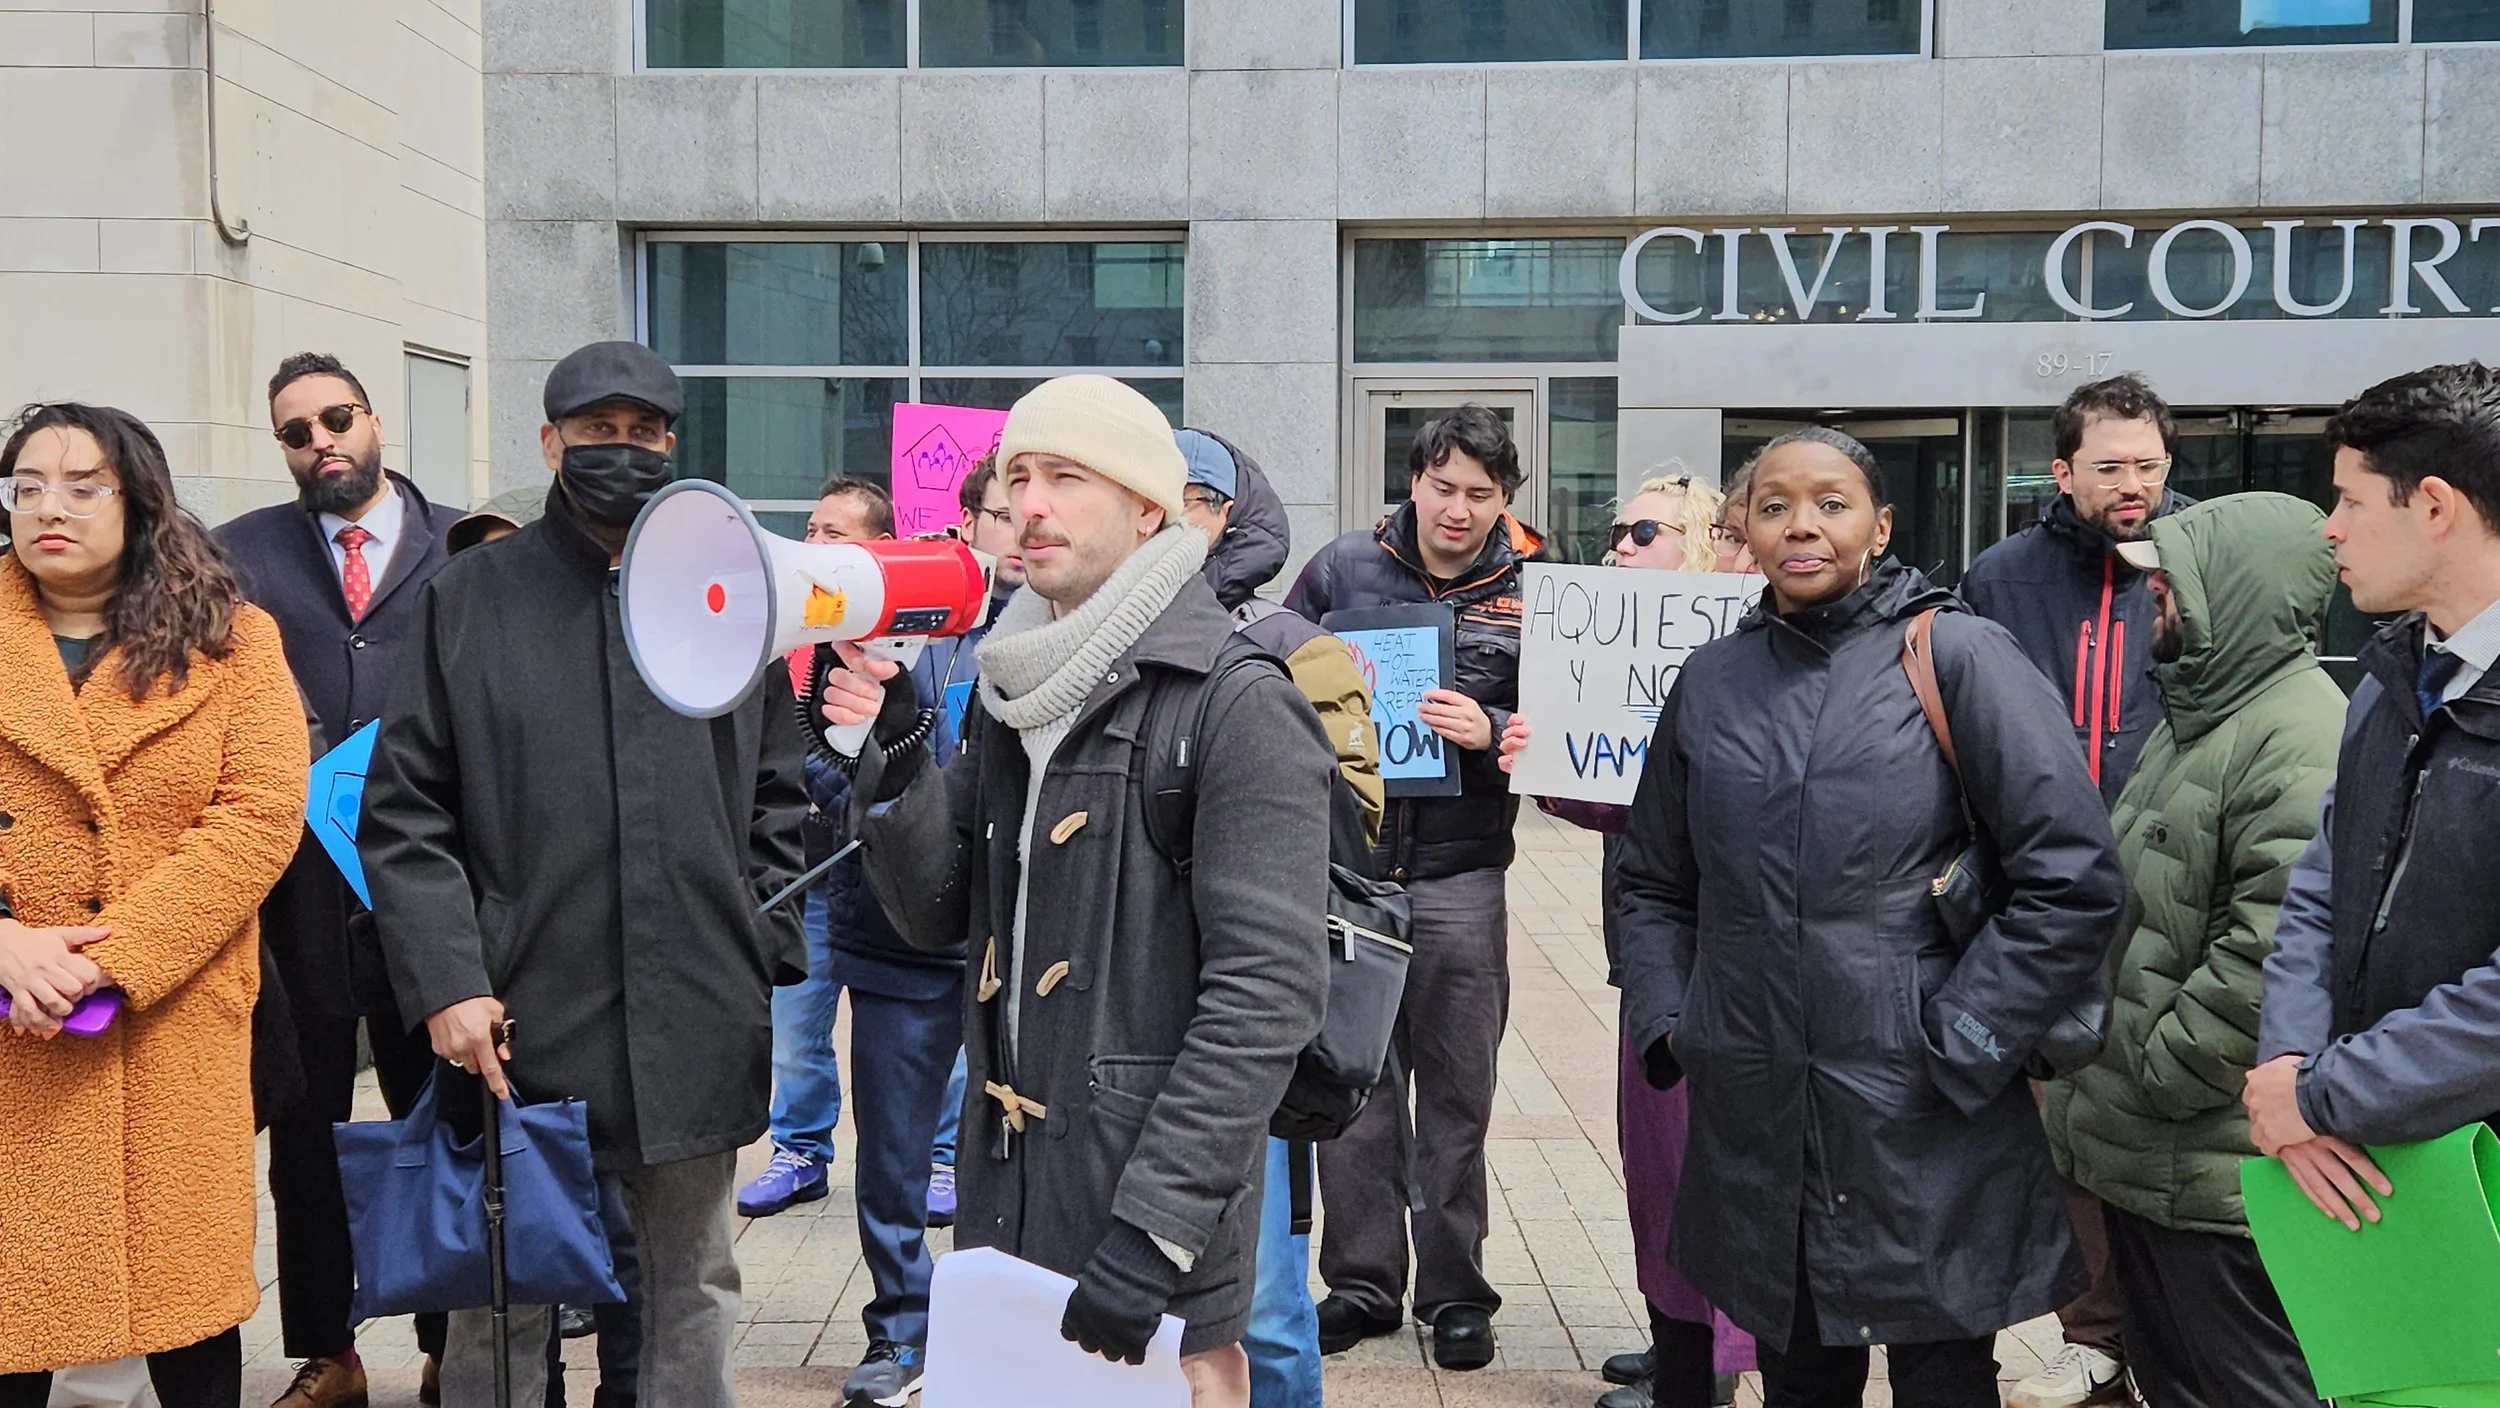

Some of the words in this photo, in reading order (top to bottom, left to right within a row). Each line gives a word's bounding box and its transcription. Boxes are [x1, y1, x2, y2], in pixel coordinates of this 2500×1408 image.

[1619, 225, 1986, 323] CIVIL
[2037, 351, 2113, 378] 89-17
[898, 507, 939, 529] WE
[1529, 574, 1639, 649] AQUI
[1657, 592, 1741, 650] EST
[1373, 633, 1416, 652] HEAT
[1380, 653, 1415, 671] HOT
[1390, 668, 1438, 688] WATER
[1566, 731, 1648, 779] VAM
